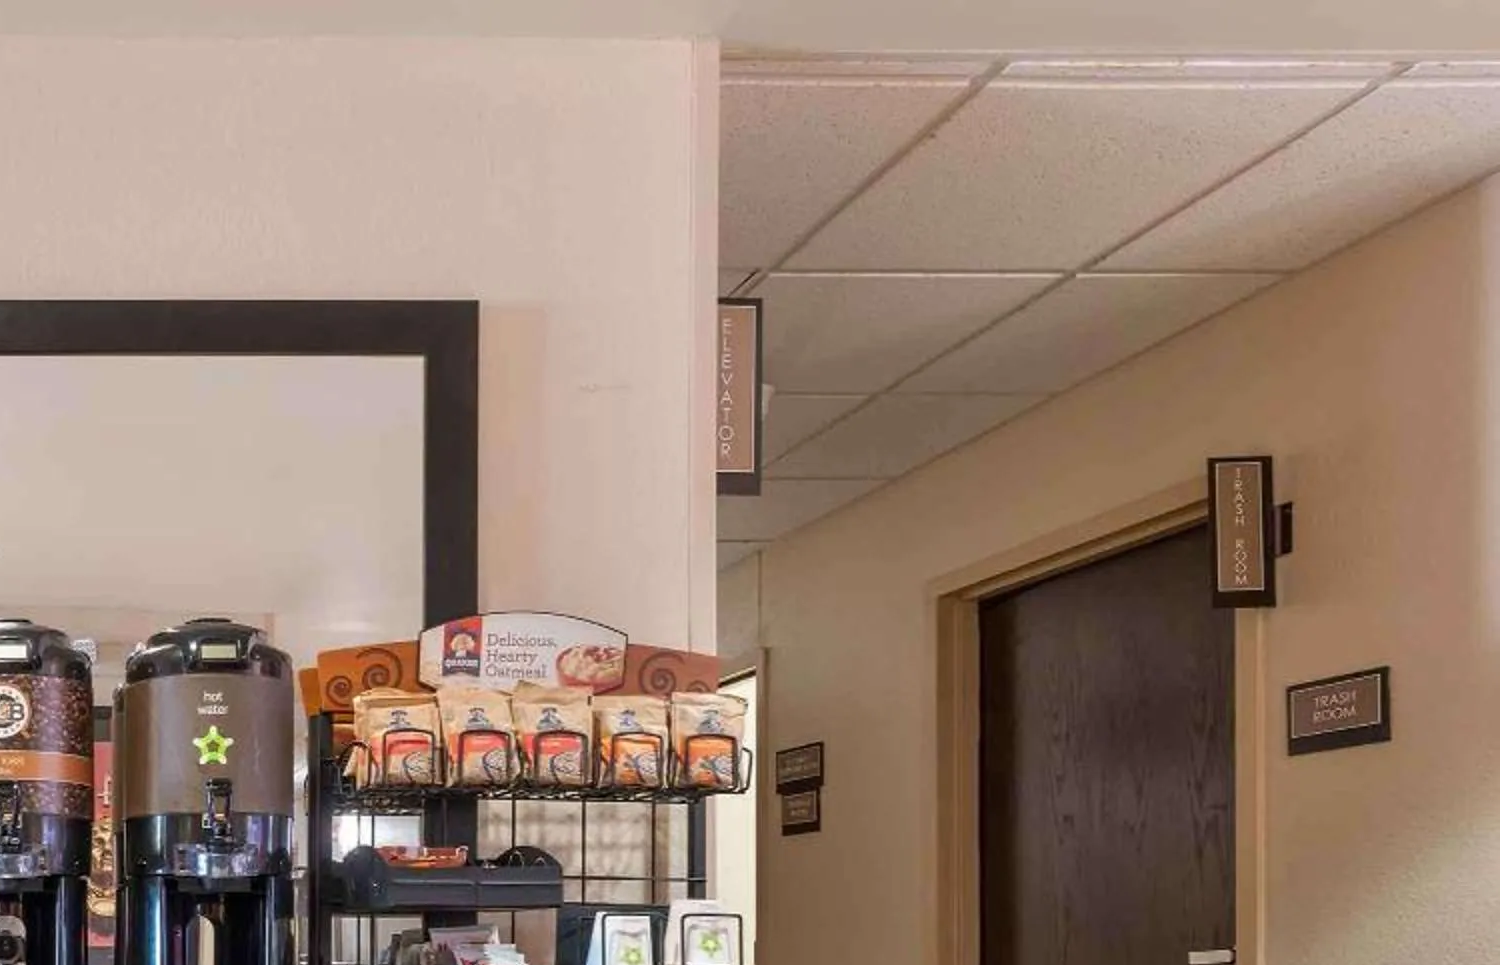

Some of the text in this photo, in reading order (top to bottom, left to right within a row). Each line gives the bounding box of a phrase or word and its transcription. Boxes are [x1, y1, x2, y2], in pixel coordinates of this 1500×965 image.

[718, 317, 735, 460] ELEVATOR
[1234, 467, 1247, 527] TRASH
[1234, 538, 1248, 585] ROOM
[486, 649, 538, 665] Hearty
[485, 665, 547, 681] Oatmeal
[203, 691, 223, 702] hot
[1314, 690, 1356, 708] TRASH
[197, 705, 229, 716] water
[1313, 705, 1357, 723] ROOM
